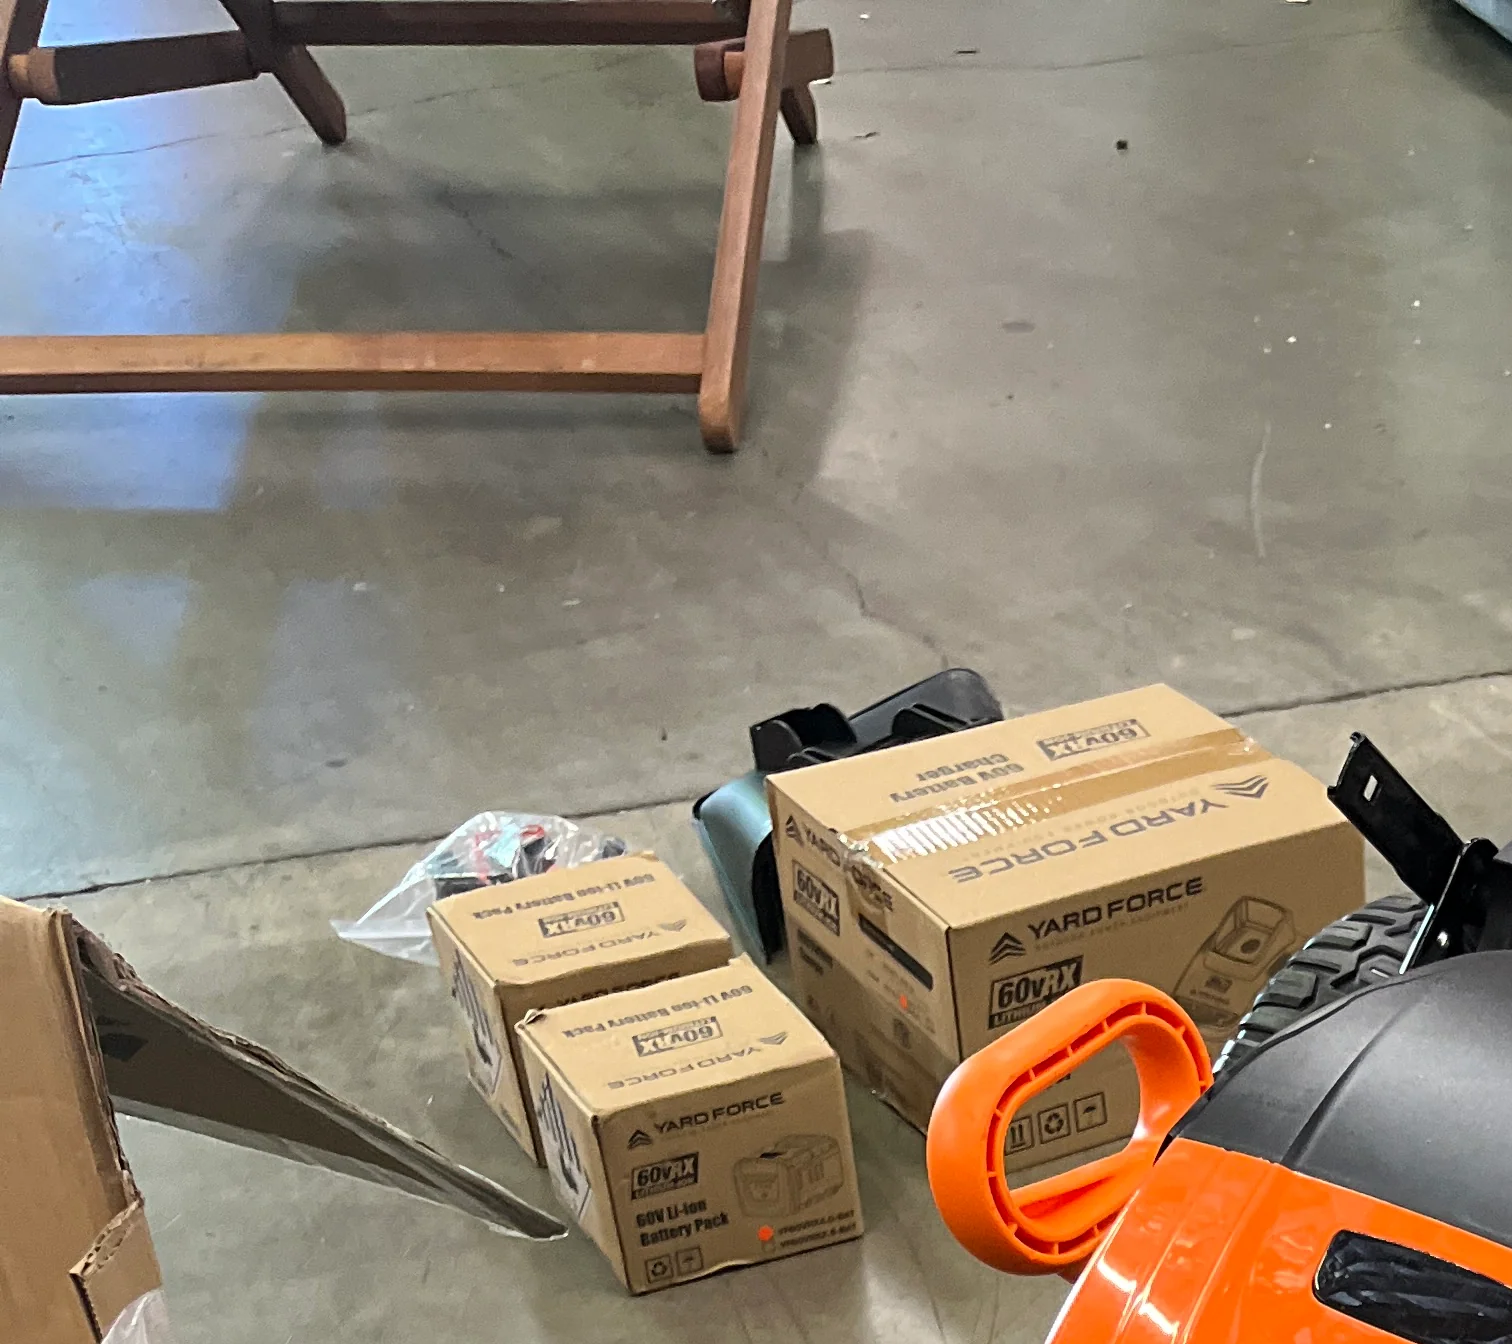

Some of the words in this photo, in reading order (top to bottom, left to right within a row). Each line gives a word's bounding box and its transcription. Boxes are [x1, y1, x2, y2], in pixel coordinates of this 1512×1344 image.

[915, 754, 1010, 783] Charger
[1108, 797, 1229, 838] YARD
[947, 829, 1110, 884] FORCE
[1028, 905, 1103, 940] YARD
[1108, 876, 1204, 920] FORCE
[599, 930, 663, 950] YARD
[699, 1046, 763, 1070] YARD
[607, 1063, 695, 1090] FORCE
[653, 1111, 711, 1135] YARD
[712, 1091, 786, 1122] FORCE
[640, 1222, 693, 1248] Battery
[693, 1212, 730, 1233] Pack
